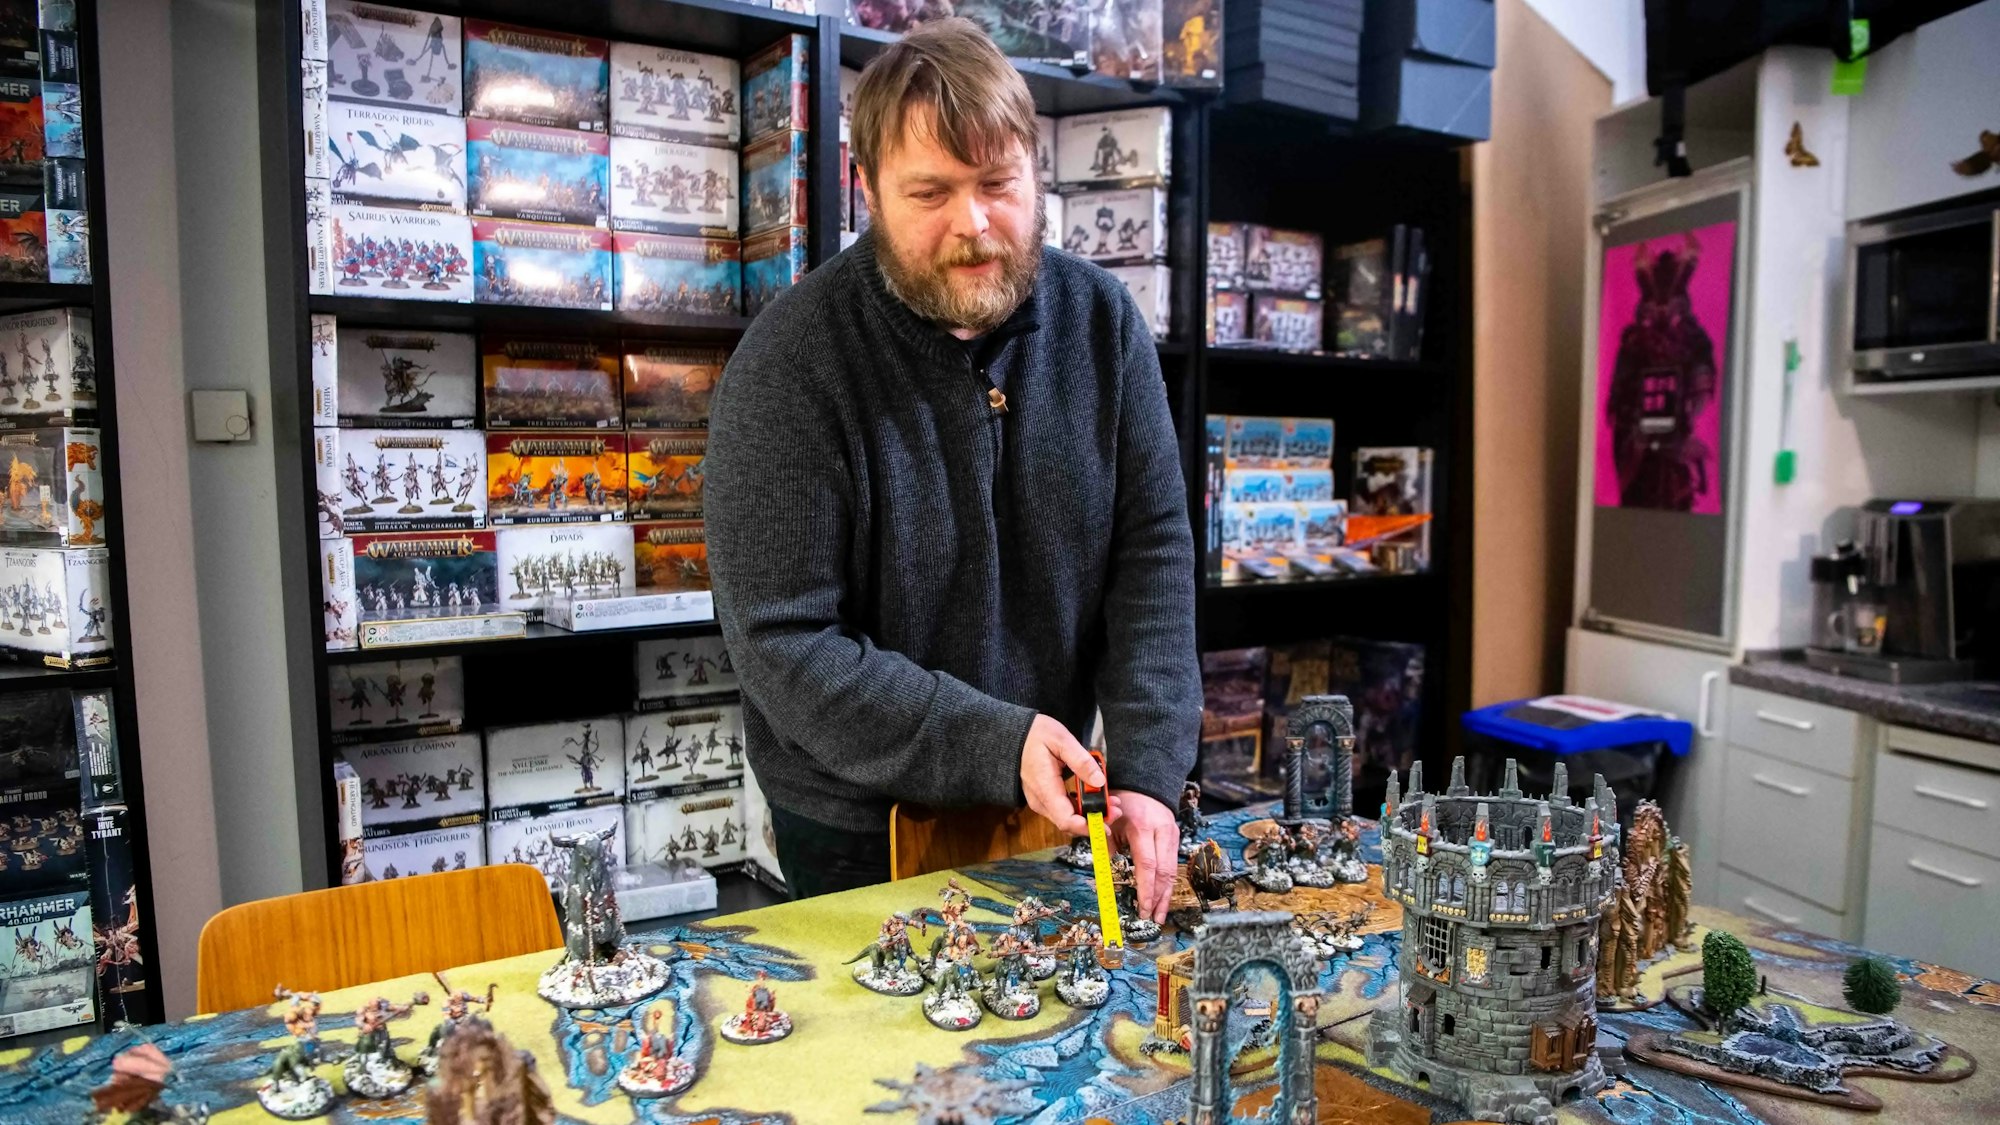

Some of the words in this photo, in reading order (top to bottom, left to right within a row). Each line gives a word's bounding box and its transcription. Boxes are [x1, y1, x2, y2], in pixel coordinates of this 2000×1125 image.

[347, 109, 399, 122] TERRADON
[402, 115, 435, 127] RIDERS
[348, 211, 386, 222] SAURUS
[389, 214, 441, 227] WARRIORS
[516, 212, 566, 222] VANQUISHERS
[325, 435, 333, 468] KHINERAI
[510, 439, 605, 457] WARHAMMER
[650, 440, 708, 456] WARHAM
[411, 522, 466, 530] WINDCHARGERS
[550, 533, 583, 544] DRYADS
[367, 539, 474, 558] WARHAMMER
[6, 557, 37, 569] TZAANGORS
[360, 747, 409, 760] ARKANAUT
[413, 741, 457, 754] COMPANY
[349, 781, 357, 827] HEARTHGUARD
[98, 820, 114, 830] HIVE
[525, 823, 564, 835] UNTAMED
[91, 828, 122, 839] TYRANT
[364, 843, 410, 854] RUNDSTOK
[414, 832, 471, 848] THUNDERERS
